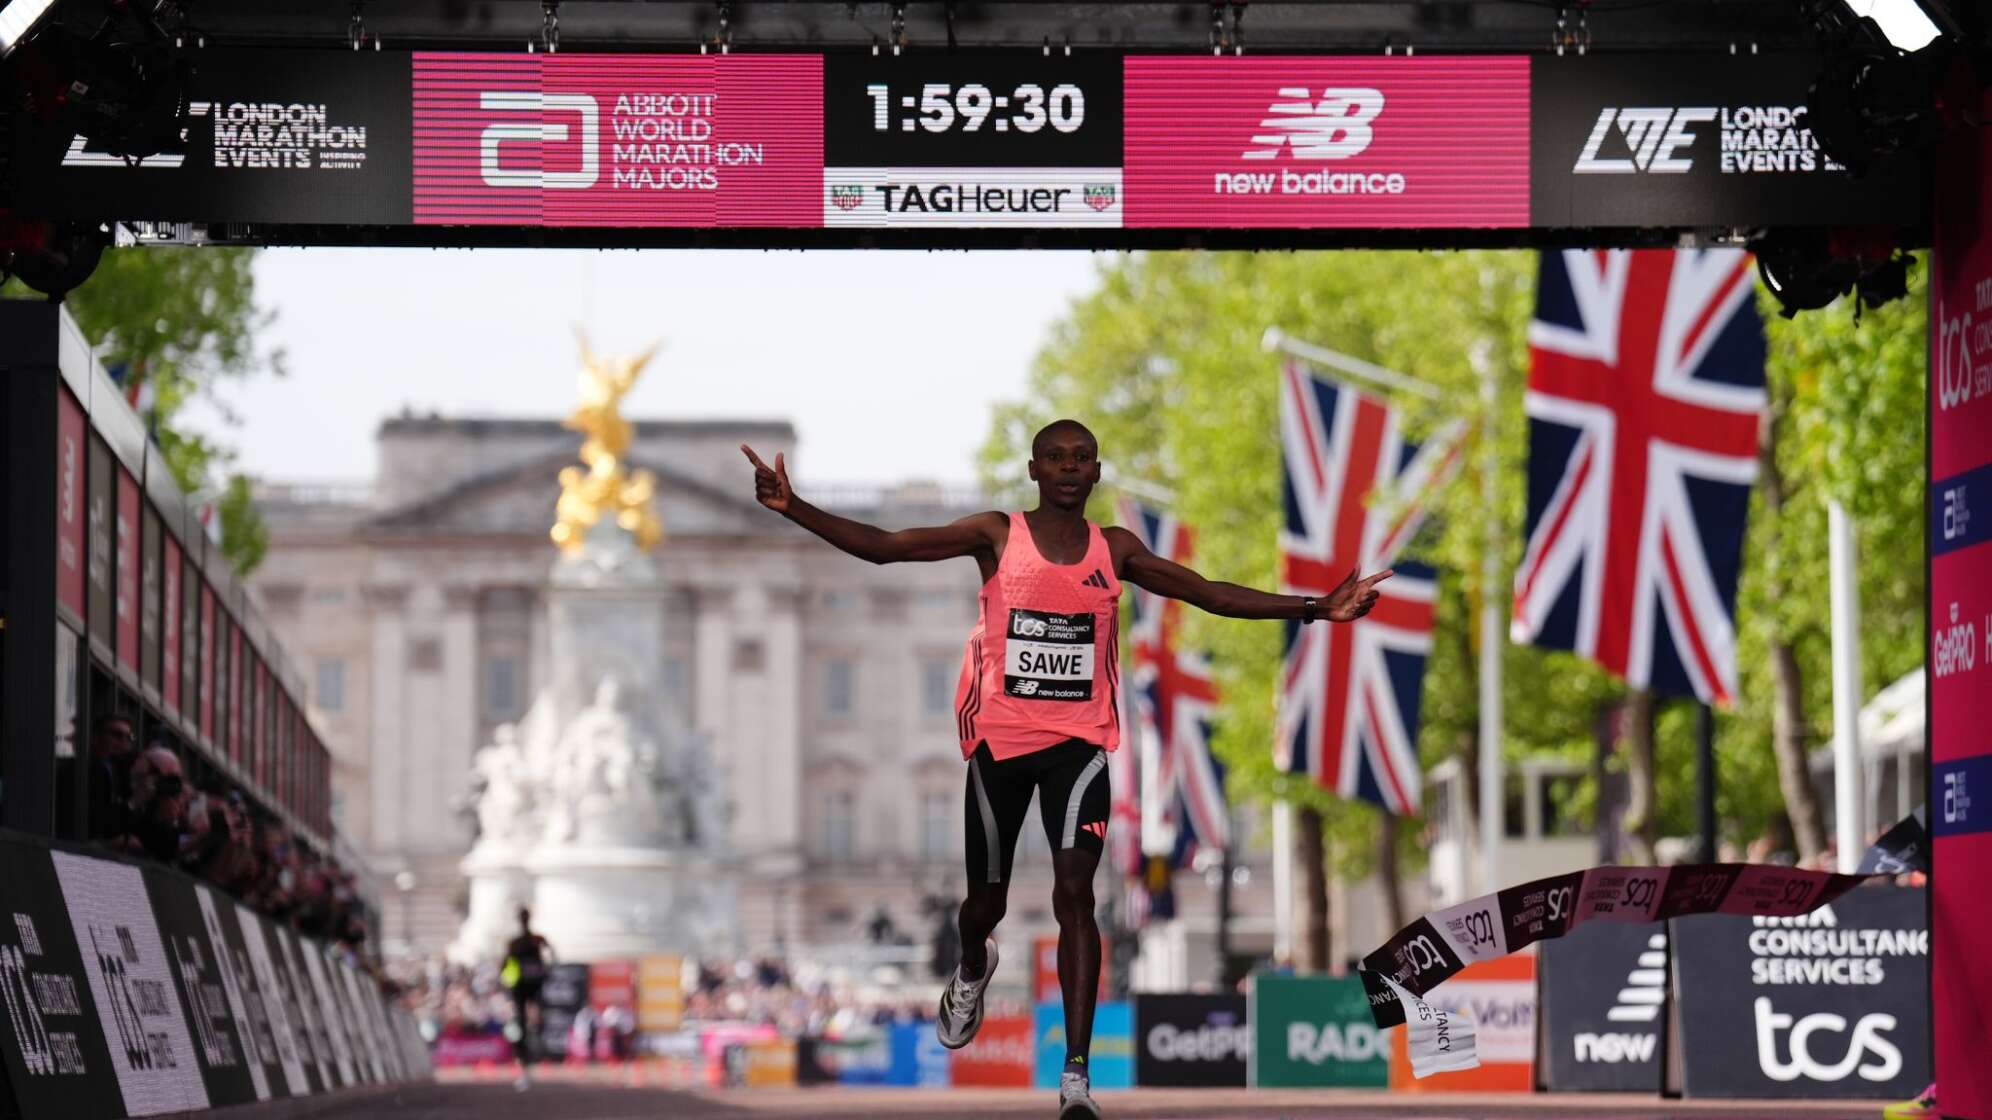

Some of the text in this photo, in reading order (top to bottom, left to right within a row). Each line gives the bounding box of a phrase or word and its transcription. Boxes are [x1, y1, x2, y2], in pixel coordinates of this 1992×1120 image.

[214, 102, 326, 124] LONDON
[613, 94, 717, 116] ABBOTT
[867, 84, 1084, 132] 1:59:30
[214, 125, 366, 148] MARATHON
[612, 119, 711, 141] WORLD
[214, 148, 310, 168] EVENTS
[613, 143, 762, 165] MARATHON
[1719, 150, 1815, 173] EVENTS
[613, 167, 718, 190] MAJORS
[1215, 168, 1404, 193] new balance
[1939, 299, 1971, 411] tcs
[1013, 613, 1048, 637] tcs
[1048, 632, 1077, 640] SERVICES
[1018, 651, 1082, 675] SAWE
[1055, 690, 1085, 698] balance
[1466, 909, 1497, 948] tcs
[1404, 935, 1447, 975] tcs
[1751, 958, 1885, 985] SERVICES
[1434, 1008, 1451, 1053] TANCY
[1754, 996, 1903, 1082] tcs
[1573, 1032, 1657, 1063] new
